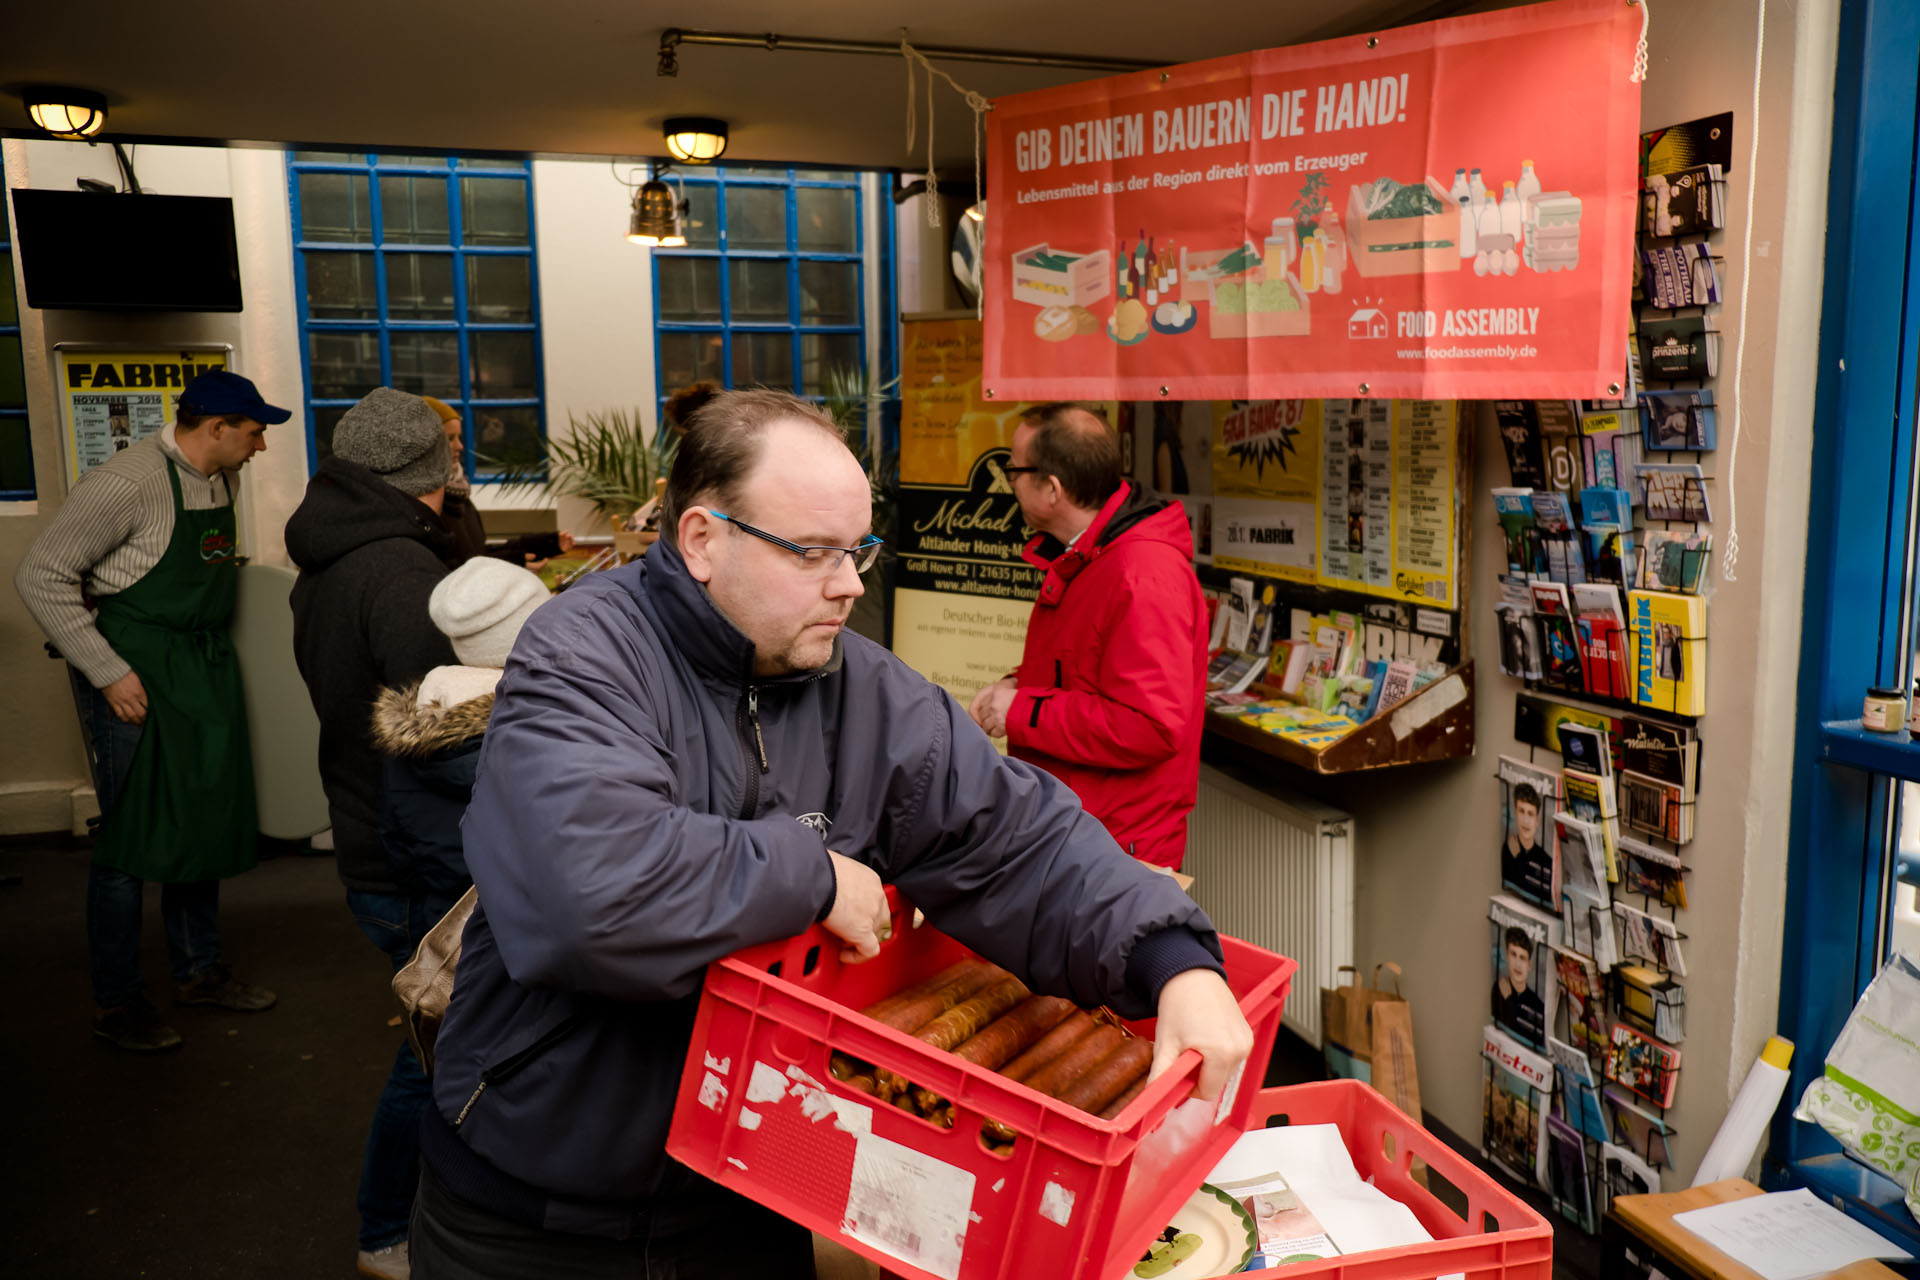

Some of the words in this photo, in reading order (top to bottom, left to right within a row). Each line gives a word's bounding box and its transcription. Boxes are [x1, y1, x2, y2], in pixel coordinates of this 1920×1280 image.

[1016, 129, 1051, 172] GIB
[1060, 113, 1143, 166] DEINEM
[1153, 97, 1251, 154] BAUERN
[1262, 89, 1307, 140] DIE
[1315, 73, 1408, 133] HAND!
[1018, 180, 1099, 204] Lebensmittel
[1103, 181, 1124, 194] aus
[1127, 175, 1149, 190] der
[1153, 171, 1201, 189] Region
[1206, 162, 1249, 181] direkt
[1254, 160, 1289, 175] vom
[1295, 152, 1368, 171] Erzeuger
[1658, 251, 1671, 277] THE
[1675, 249, 1692, 304] POTHEAD
[1397, 310, 1436, 338] FOOD
[1442, 307, 1540, 337] ASSEMBLY
[1397, 345, 1537, 360] www.foodassembly.de
[73, 395, 128, 405] NOVEMBER
[137, 395, 161, 405] 2016
[914, 497, 1019, 534] Michael
[919, 535, 971, 554] Altländer
[974, 540, 1025, 558] Honig-M
[1250, 528, 1295, 545] FABRIK
[907, 558, 928, 573] Groß
[930, 561, 953, 574] Hove
[956, 564, 969, 577] 82
[979, 566, 1010, 580] 21635
[1012, 569, 1032, 583] Jork
[1034, 571, 1047, 585] (A
[943, 608, 993, 625] Deutscher
[1636, 596, 1653, 703] FABRIK
[1485, 1039, 1534, 1080] piste
